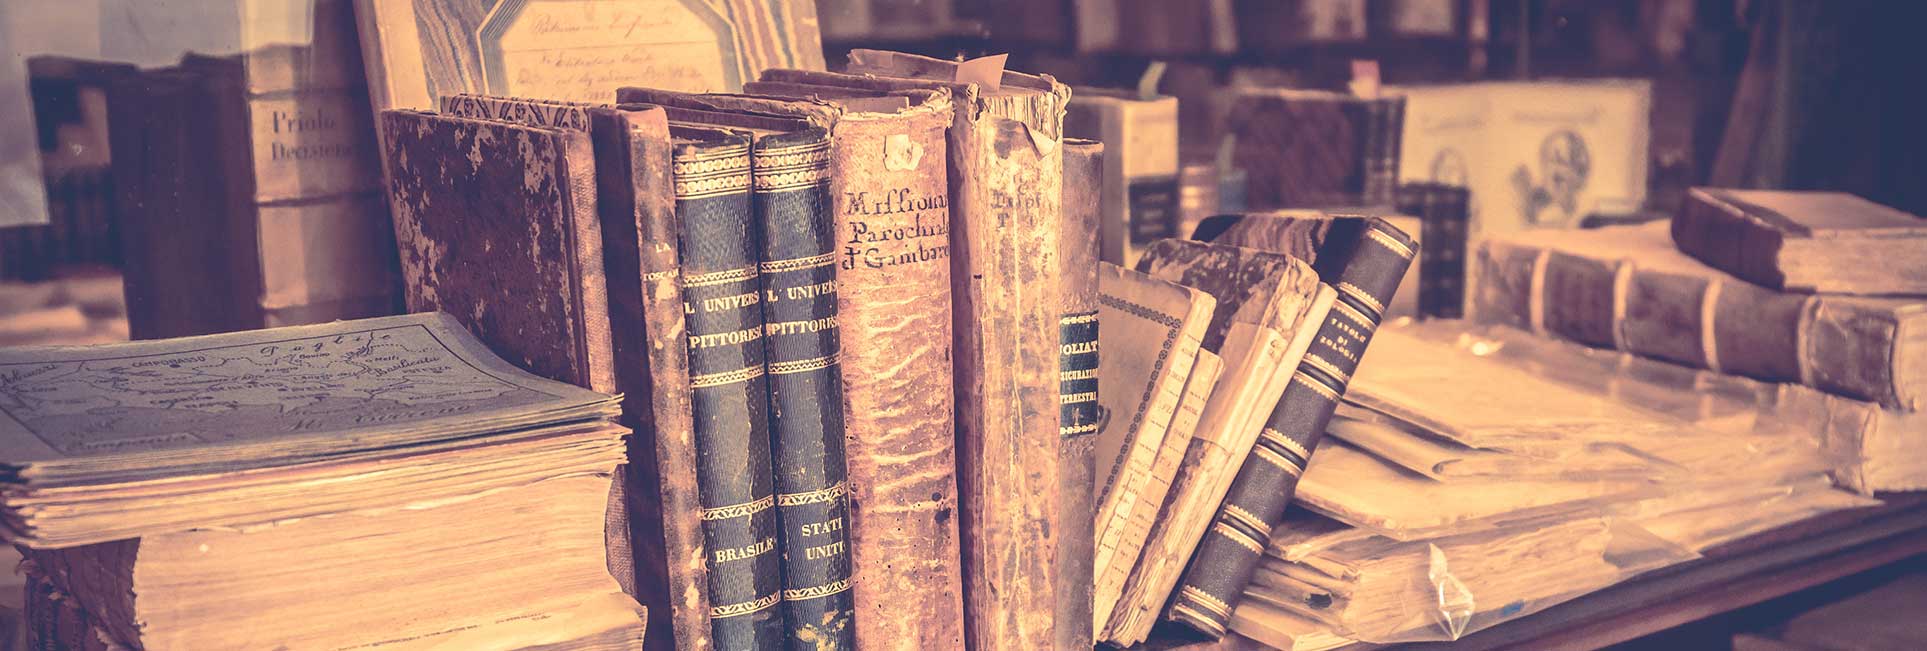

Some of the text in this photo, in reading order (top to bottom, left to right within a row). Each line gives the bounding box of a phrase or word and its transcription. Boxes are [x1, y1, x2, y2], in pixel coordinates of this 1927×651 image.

[802, 516, 843, 537] STATI
[715, 537, 775, 563] BRASILE
[805, 540, 845, 560] UNITI
